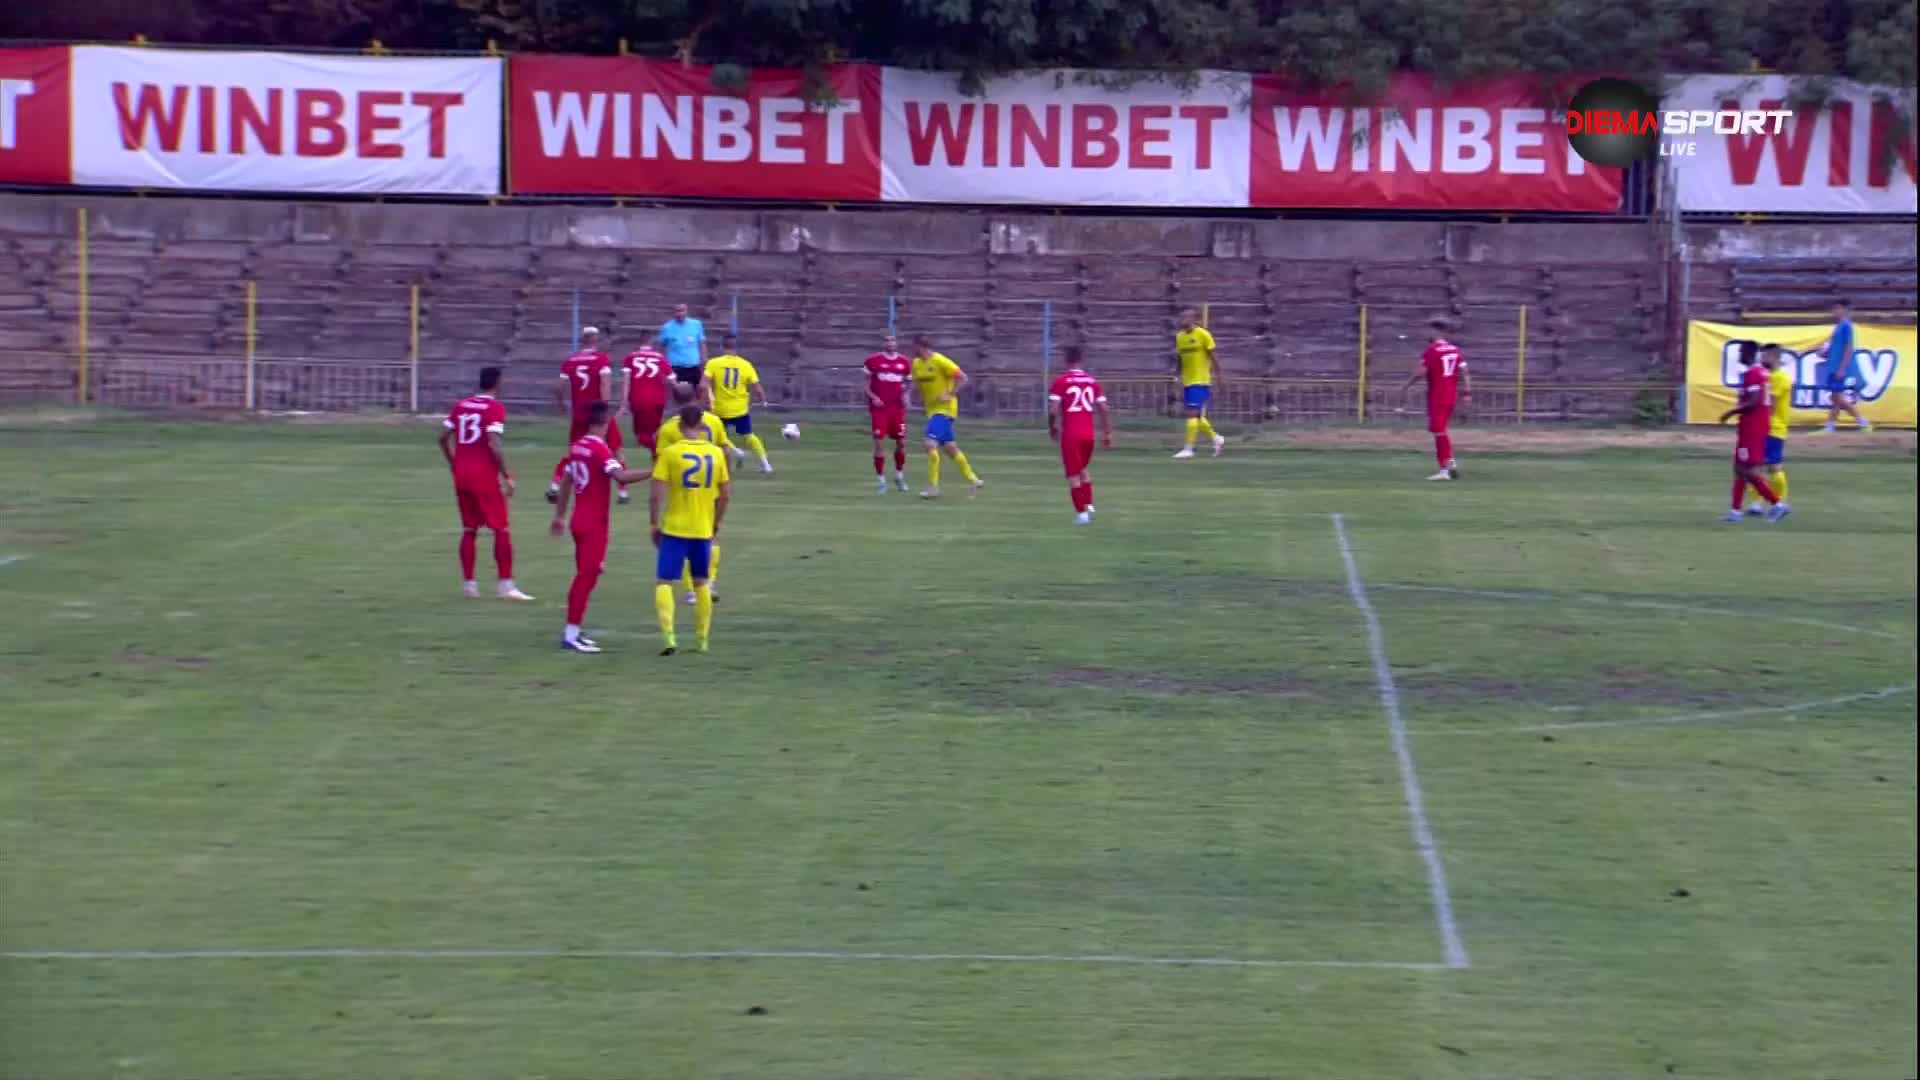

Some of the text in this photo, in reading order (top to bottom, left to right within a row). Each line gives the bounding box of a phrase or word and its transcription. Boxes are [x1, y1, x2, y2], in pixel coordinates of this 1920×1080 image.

[112, 82, 464, 158] WINBET
[533, 91, 861, 164] WINBET
[904, 101, 1228, 169] WINBET
[576, 366, 590, 390] 5
[632, 357, 660, 378] 55
[723, 368, 739, 388] 11
[1440, 353, 1459, 376] 17
[1066, 386, 1095, 412] 20
[458, 413, 481, 444] 13
[682, 454, 713, 488] 21
